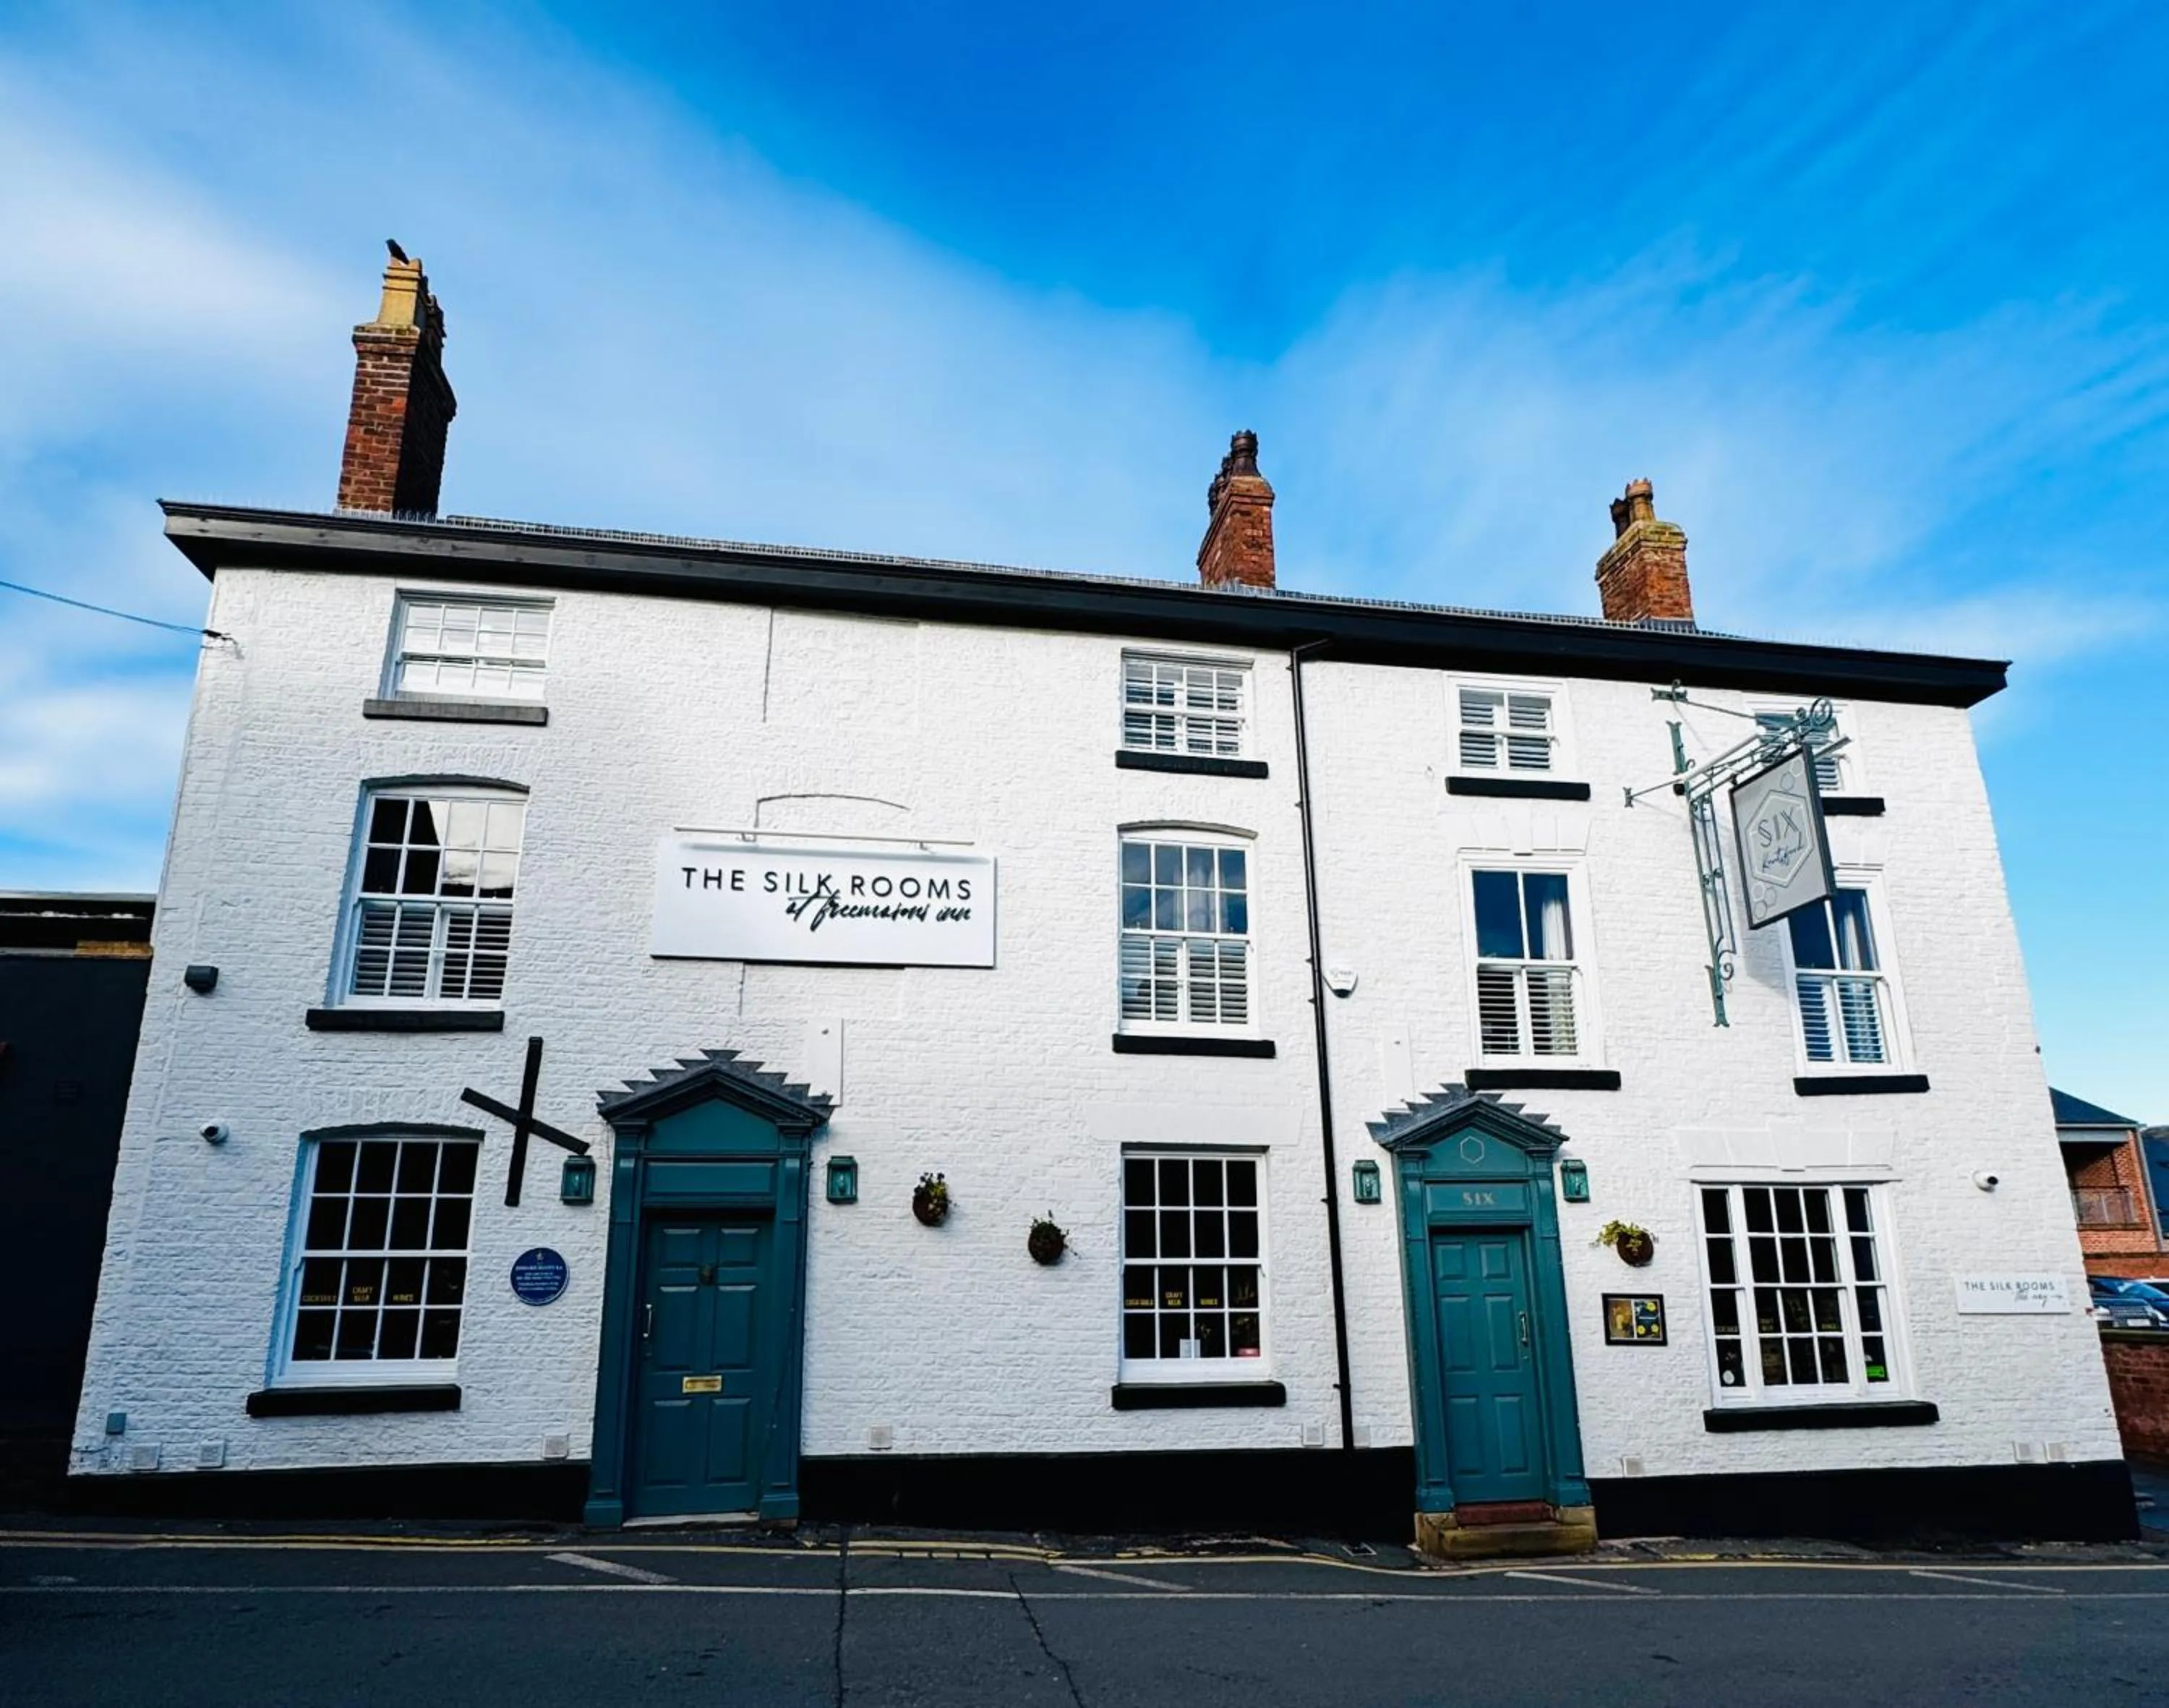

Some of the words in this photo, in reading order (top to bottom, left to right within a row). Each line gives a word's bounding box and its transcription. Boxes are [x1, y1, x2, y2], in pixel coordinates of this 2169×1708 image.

[1758, 806, 1799, 847] SIX
[682, 867, 745, 891] THE
[763, 871, 833, 895] SILK
[851, 875, 971, 900] ROOMS
[1462, 1191, 1495, 1205] SIX
[1964, 1281, 1986, 1291] THE
[1990, 1281, 2012, 1291] SILK
[2016, 1281, 2055, 1291] ROOMS
